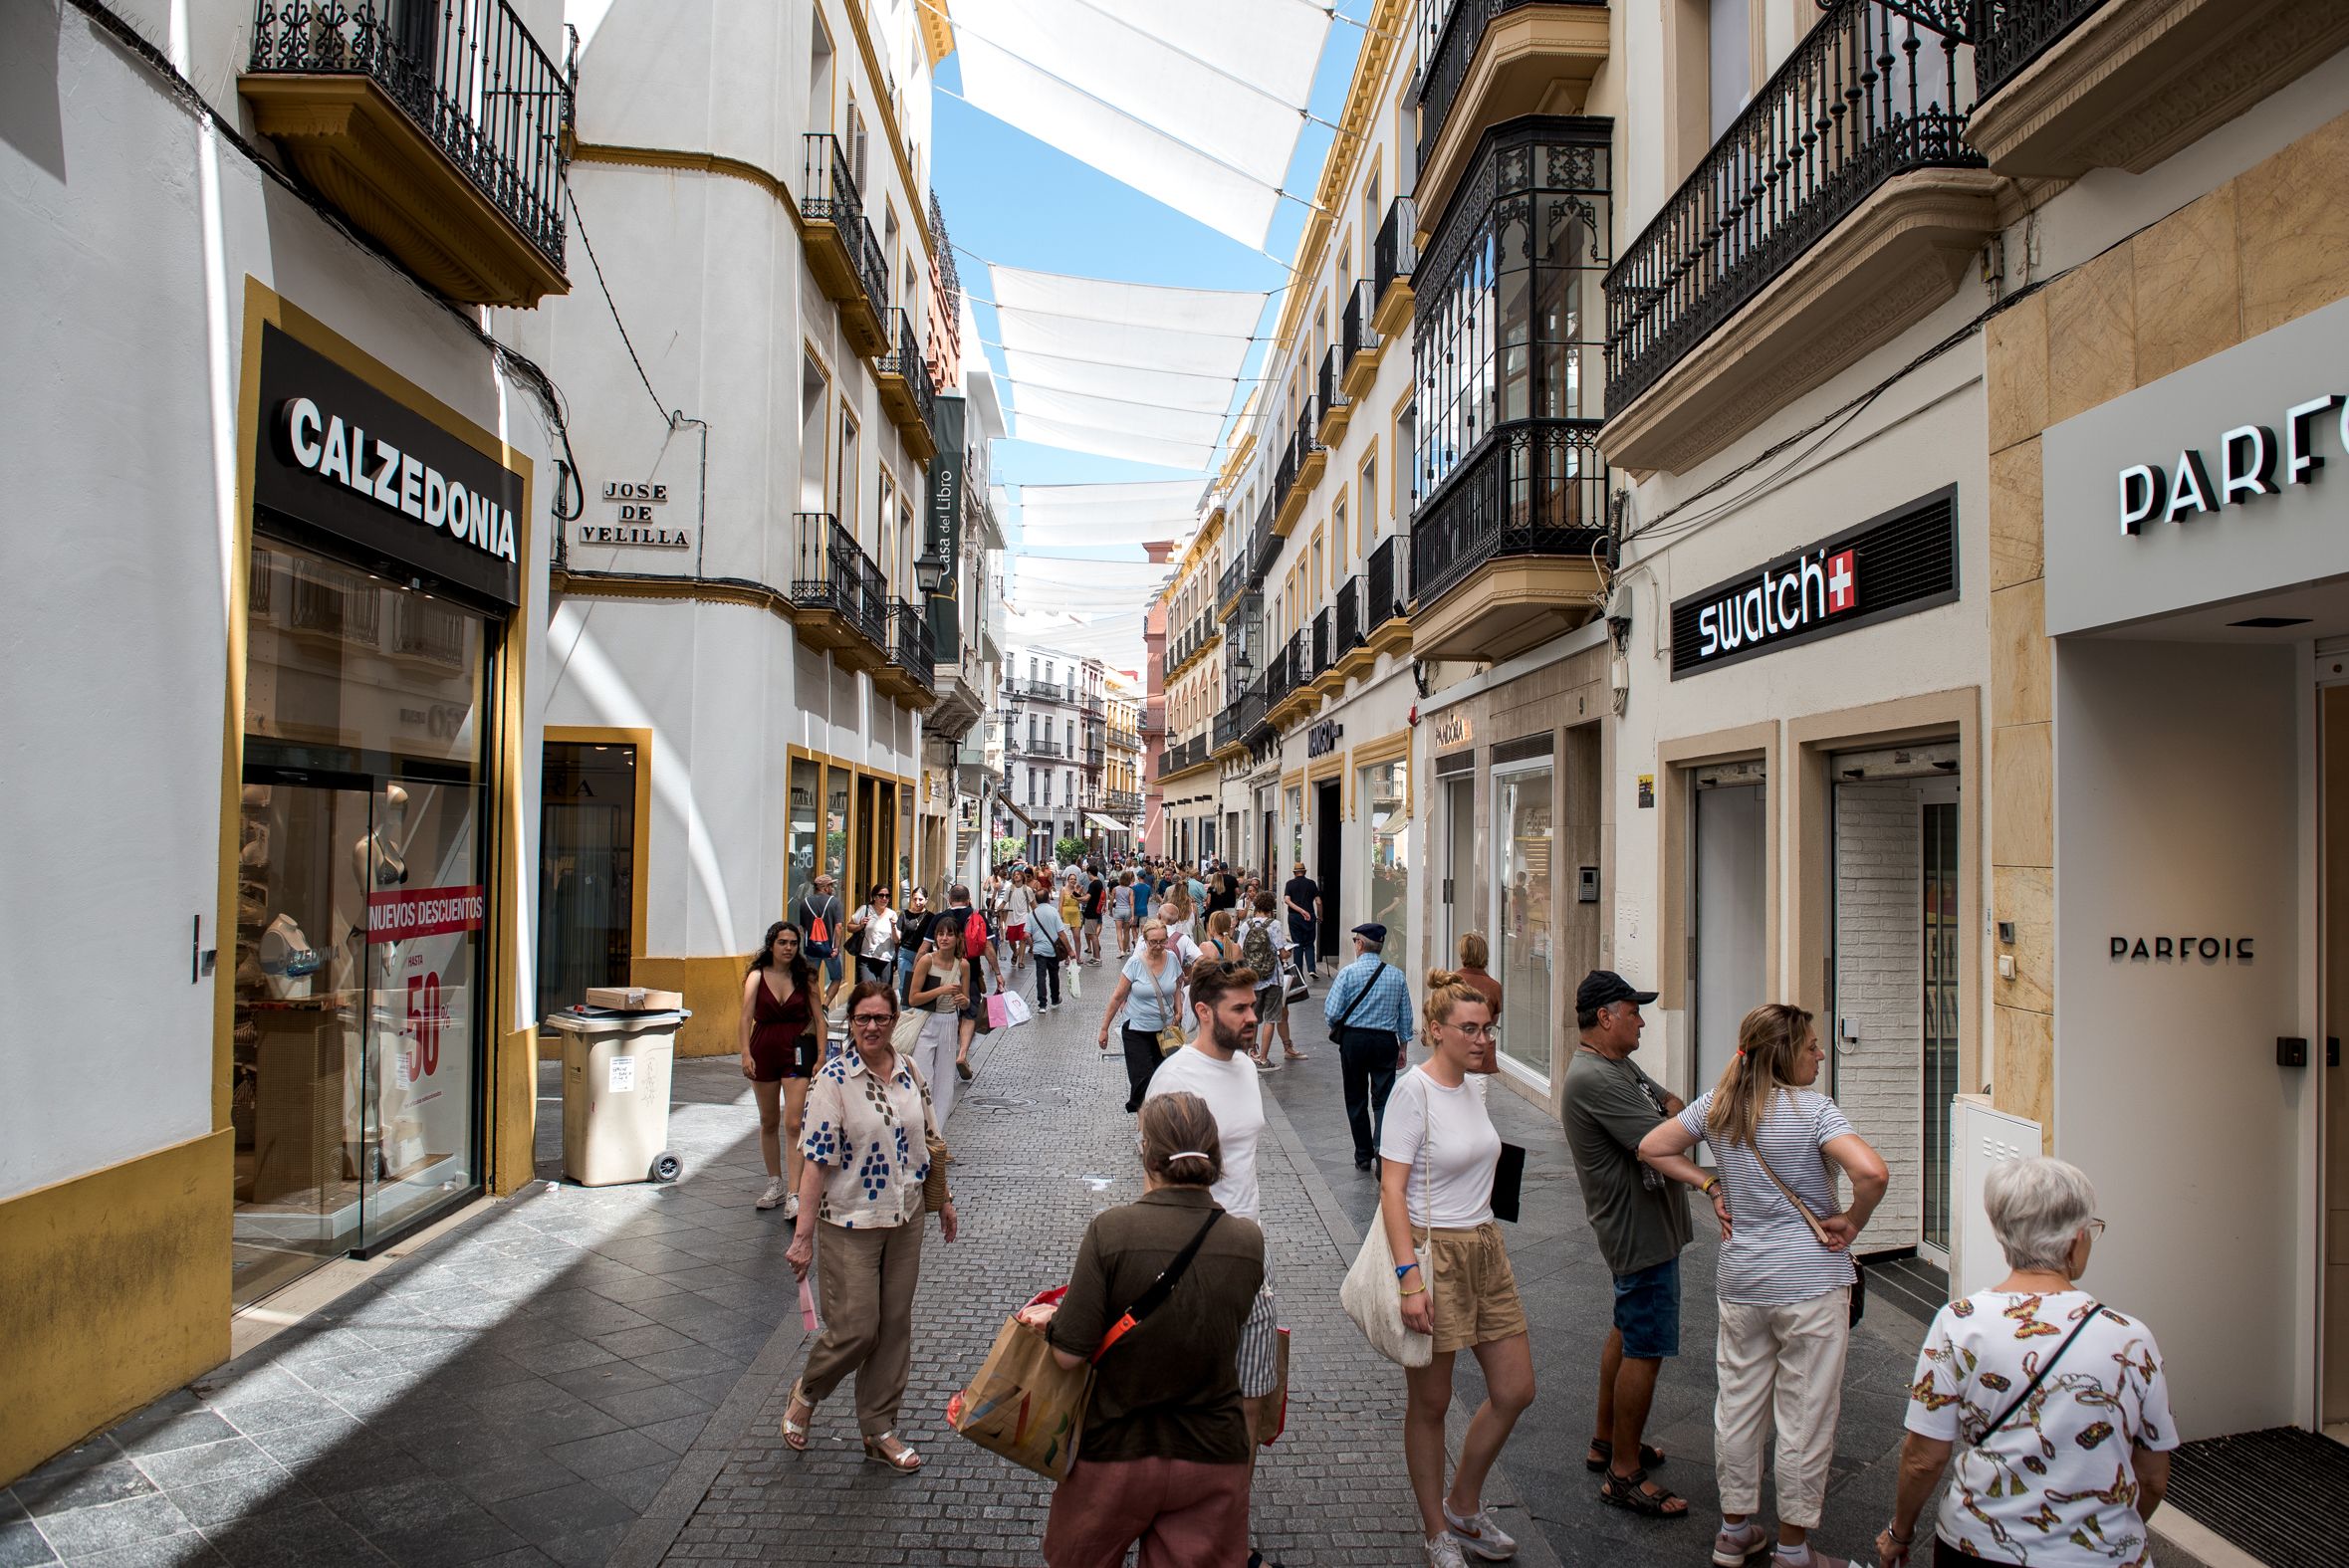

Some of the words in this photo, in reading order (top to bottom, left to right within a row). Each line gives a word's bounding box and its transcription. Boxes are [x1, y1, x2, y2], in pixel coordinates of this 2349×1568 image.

[2119, 394, 2349, 535] PARF
[291, 397, 516, 563] CALZEDONIA
[604, 482, 666, 500] JOSE
[936, 470, 952, 510] Libro
[621, 505, 651, 521] DE
[583, 526, 689, 546] VELILLA
[940, 516, 950, 534] del
[1699, 555, 1826, 657] swatch
[1579, 696, 1584, 715] 9
[1436, 715, 1465, 747] PANDORA
[368, 902, 415, 931] NUEVOS
[418, 896, 483, 925] DESCUENTOS
[2110, 937, 2254, 959] PARFOIS
[408, 954, 423, 967] HASTA
